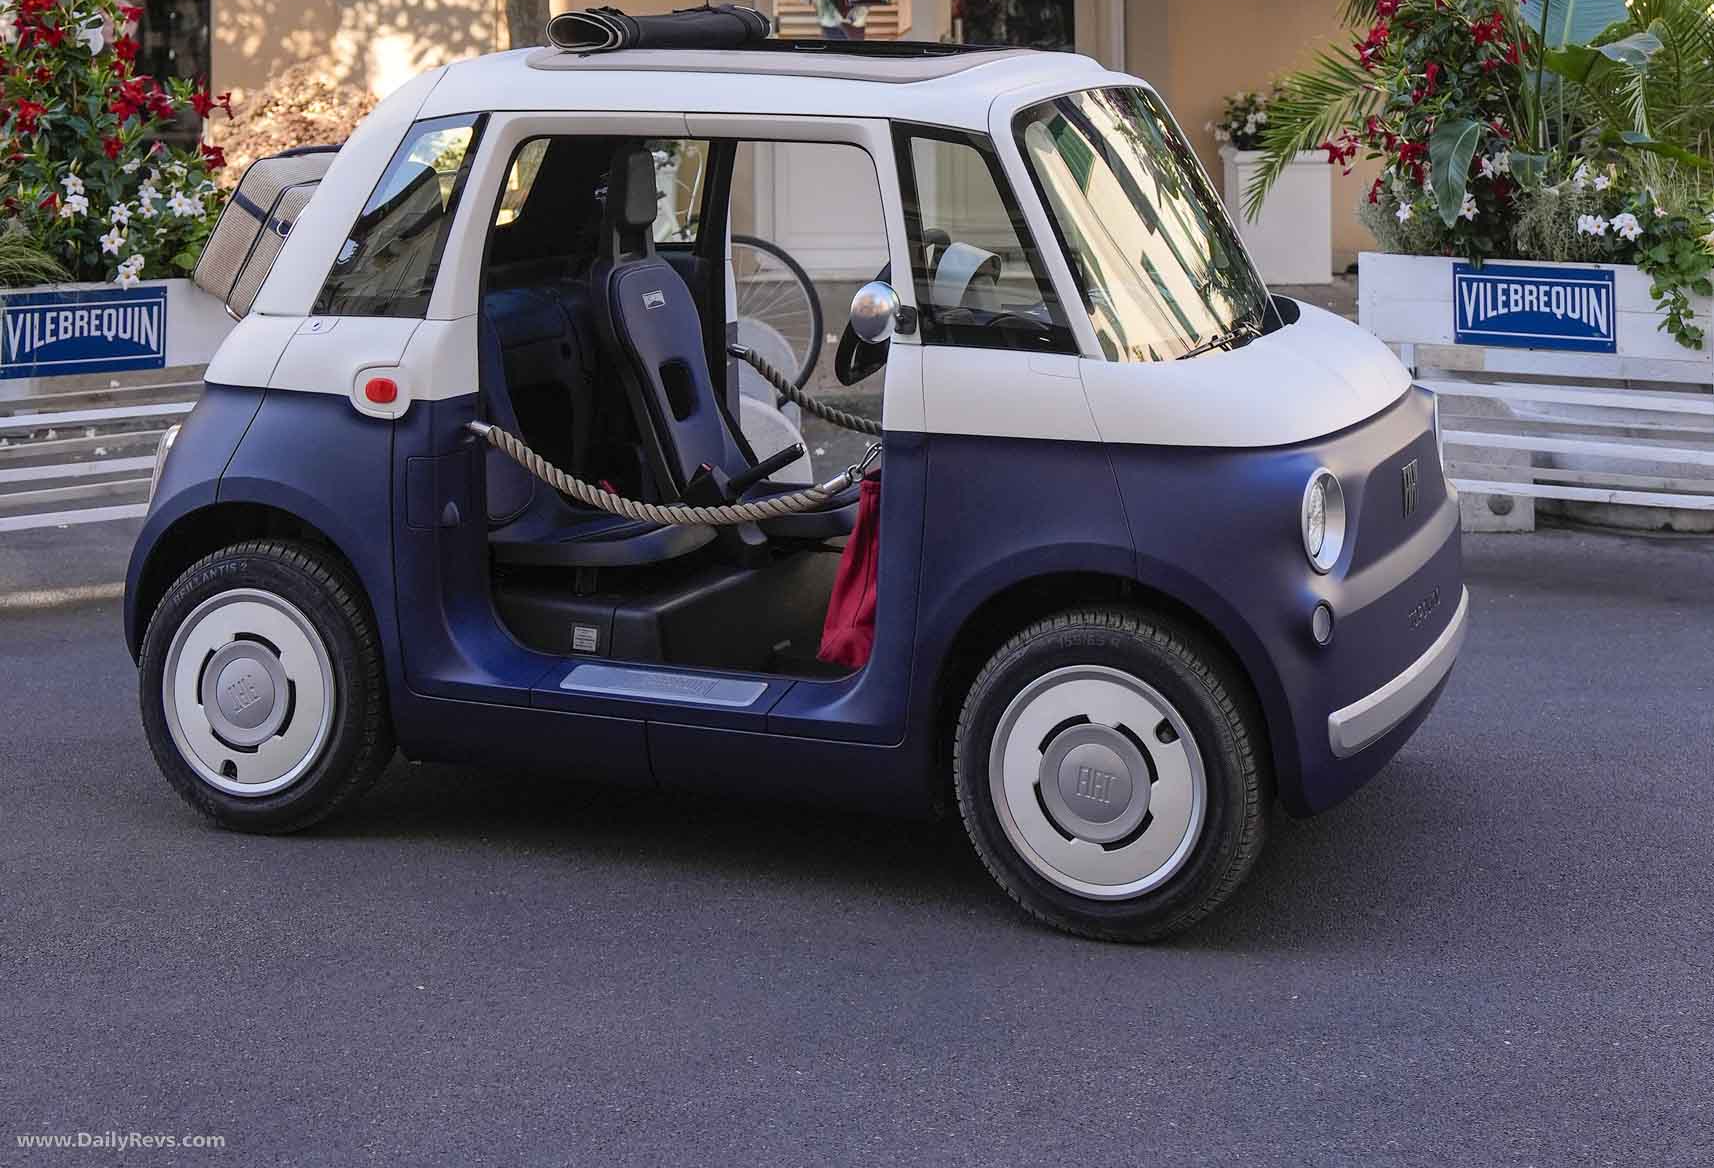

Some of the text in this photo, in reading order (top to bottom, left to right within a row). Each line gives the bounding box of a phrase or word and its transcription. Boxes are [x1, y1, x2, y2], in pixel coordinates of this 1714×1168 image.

[6, 305, 160, 362] VILEBREQUIN
[1461, 281, 1608, 336] VILEBREQUIN
[1074, 766, 1121, 805] FIAT
